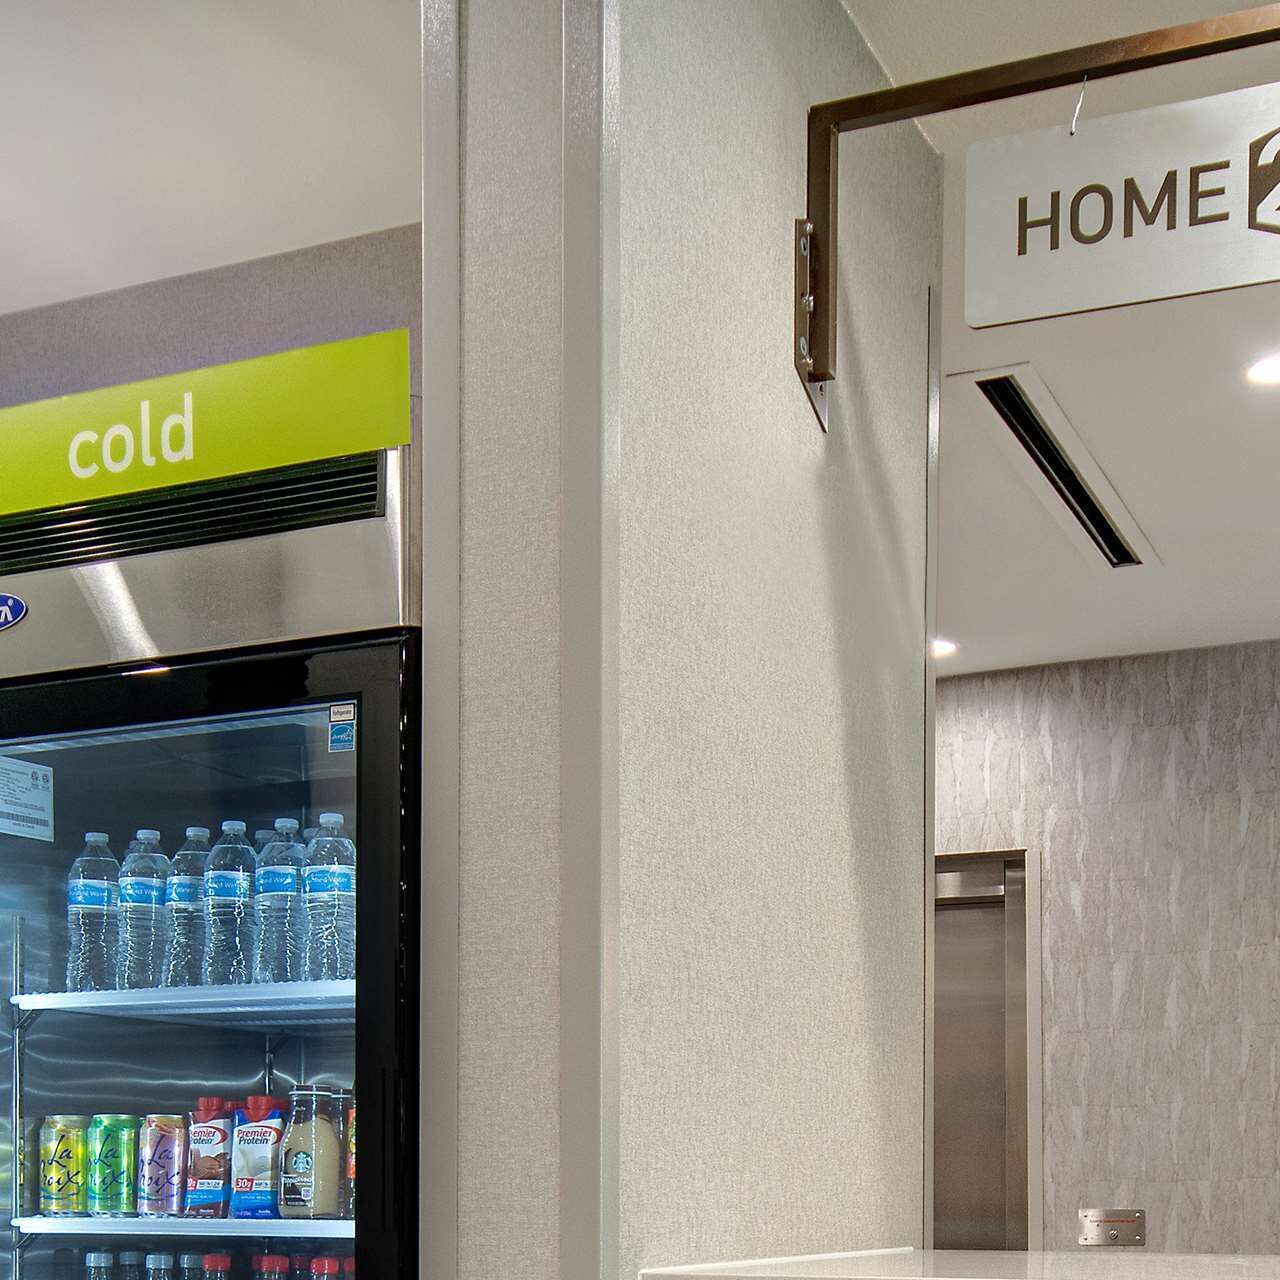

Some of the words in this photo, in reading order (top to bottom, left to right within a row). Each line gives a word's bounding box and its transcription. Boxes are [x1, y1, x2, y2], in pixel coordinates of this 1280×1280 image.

[1018, 159, 1230, 256] HOME
[68, 392, 195, 479] cold
[94, 1133, 119, 1168] La
[236, 1129, 271, 1138] Premier
[238, 1137, 269, 1145] Protein
[48, 1134, 73, 1168] La
[148, 1135, 173, 1168] La
